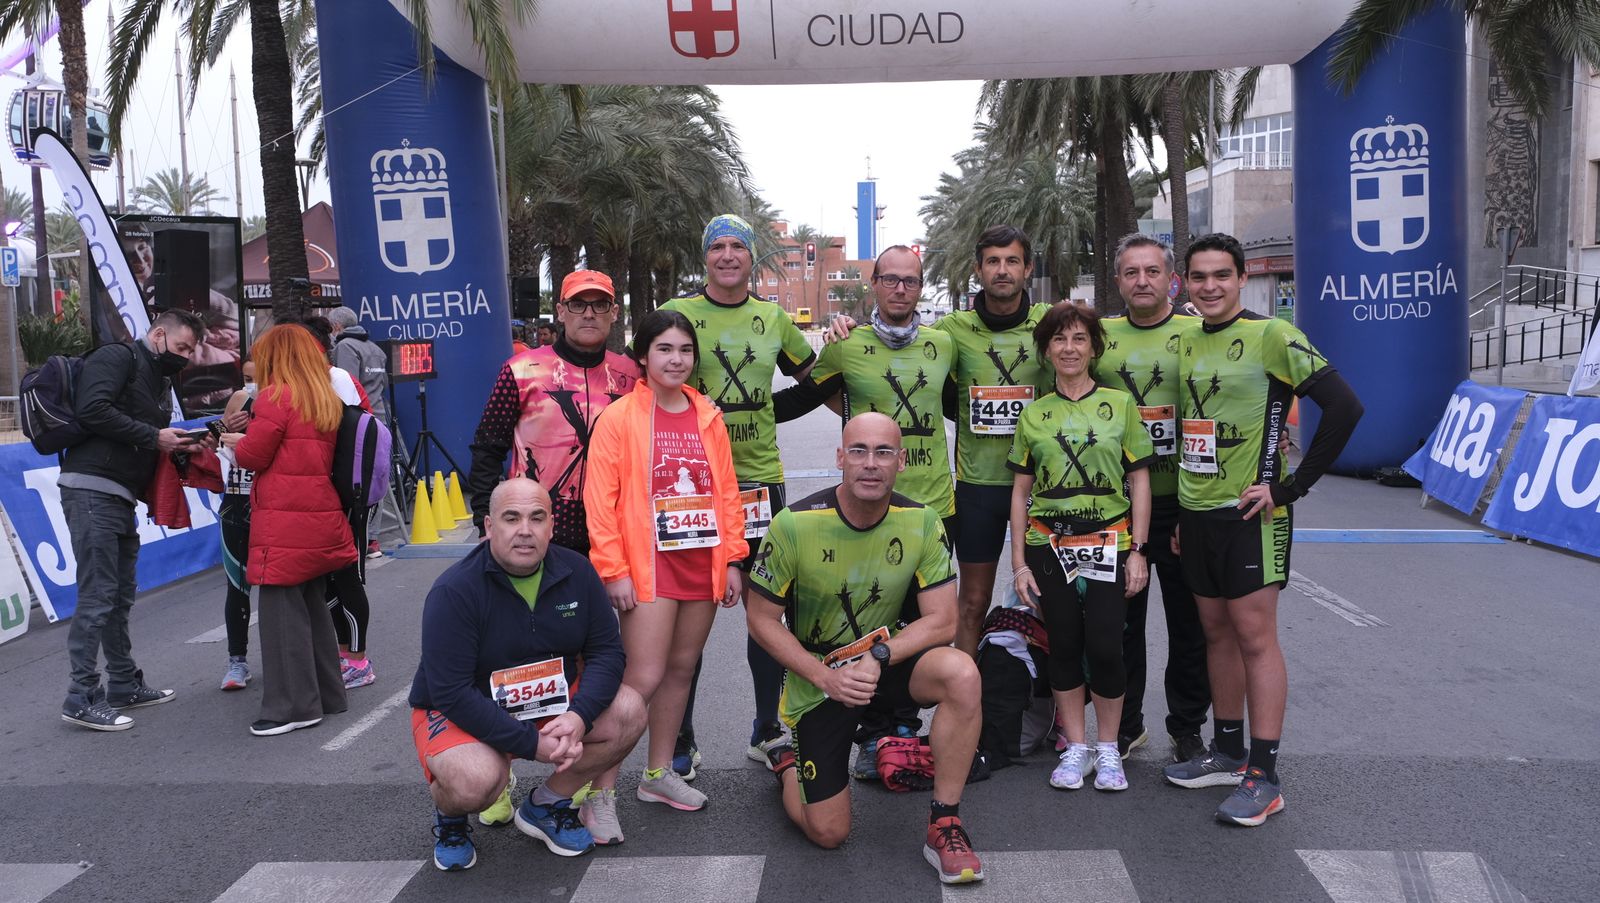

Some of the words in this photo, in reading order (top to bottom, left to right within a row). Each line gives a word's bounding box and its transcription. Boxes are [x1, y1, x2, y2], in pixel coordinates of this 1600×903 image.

[807, 12, 964, 47] CIUDAD
[3, 249, 16, 272] P
[1319, 262, 1458, 301] ALMERÍA
[359, 283, 492, 323] ALMERÍA
[1352, 301, 1432, 322] CIUDAD
[388, 321, 464, 341] CIUDAD
[981, 401, 1024, 418] 449
[668, 513, 709, 530] 3445
[1064, 547, 1105, 562] 565
[508, 680, 557, 704] 3544
